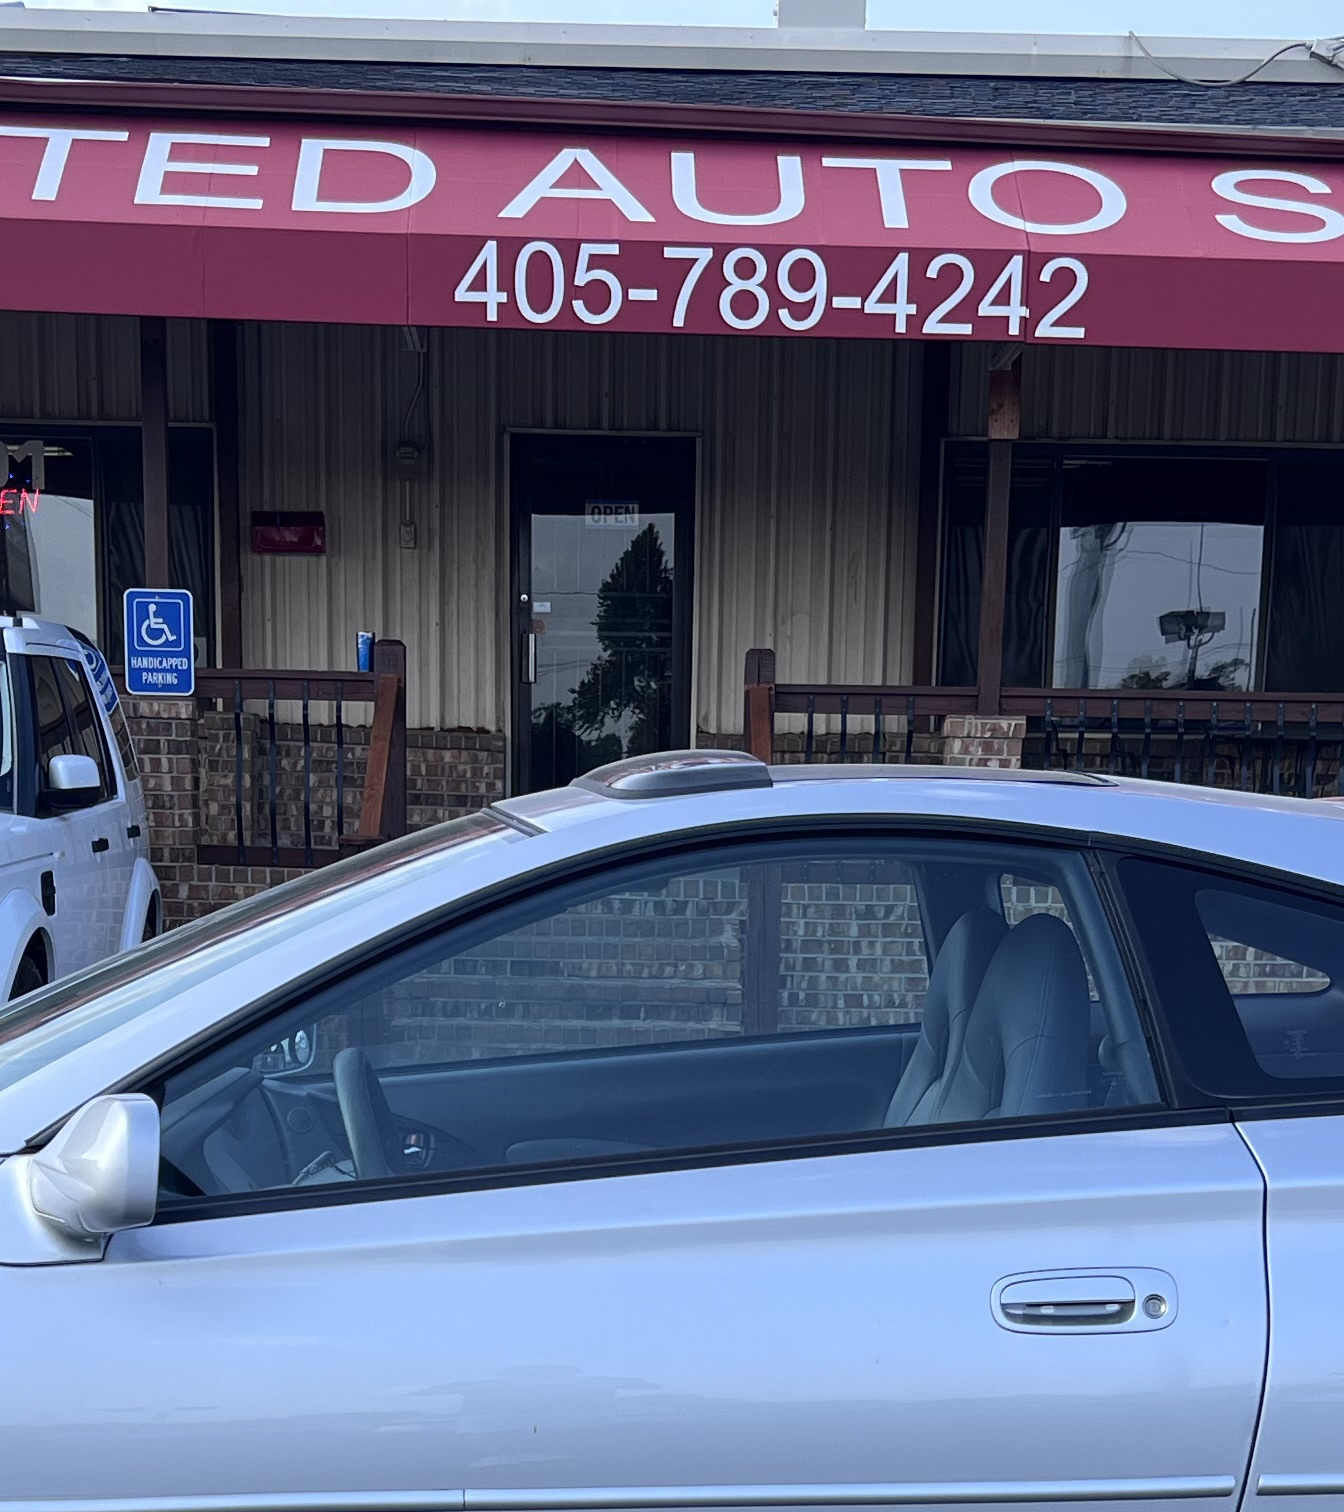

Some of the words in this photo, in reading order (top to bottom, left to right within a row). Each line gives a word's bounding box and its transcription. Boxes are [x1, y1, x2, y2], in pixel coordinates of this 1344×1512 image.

[496, 148, 1128, 236] AUTO
[454, 239, 1089, 339] 405-789-4242
[590, 505, 636, 524] OPEN
[130, 656, 189, 670] HANDICAPPED
[141, 672, 178, 685] PARKING
